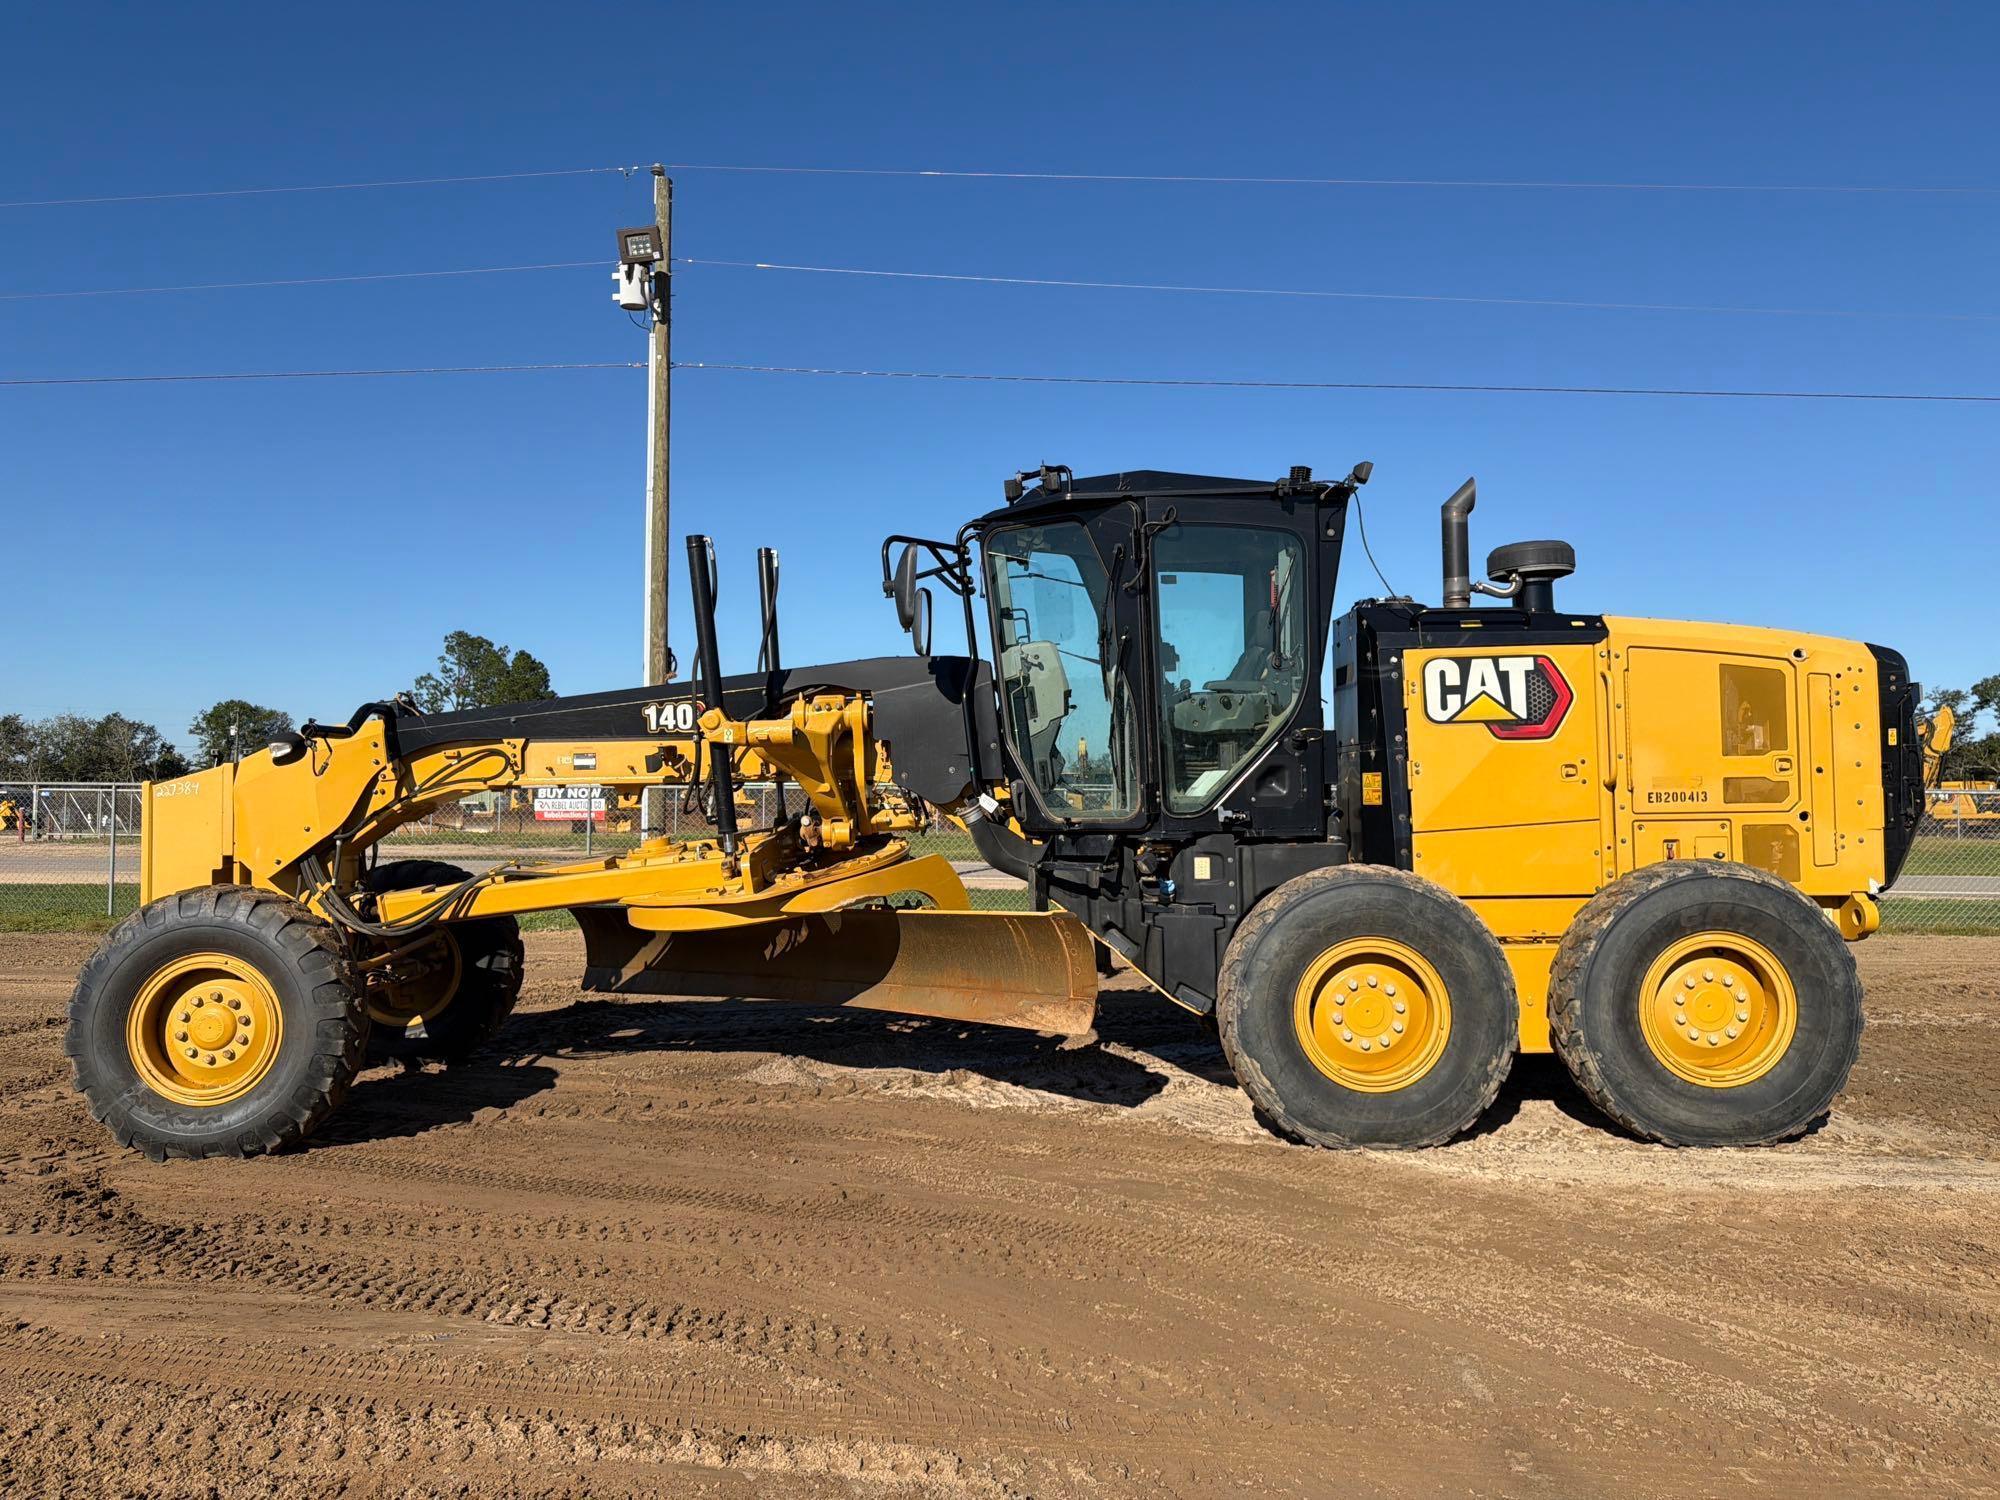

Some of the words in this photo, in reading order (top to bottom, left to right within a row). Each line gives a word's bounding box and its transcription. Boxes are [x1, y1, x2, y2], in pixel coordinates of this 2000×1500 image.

[1424, 657, 1535, 721] CAT
[644, 703, 693, 730] 140
[155, 781, 200, 797] 227384
[538, 788, 564, 798] BUY
[567, 788, 602, 798] NOW
[1647, 791, 1708, 803] EB200413
[551, 801, 567, 809] REBEL
[568, 801, 592, 809] AUCTIO
[543, 811, 596, 819] RebelAuction.cm
